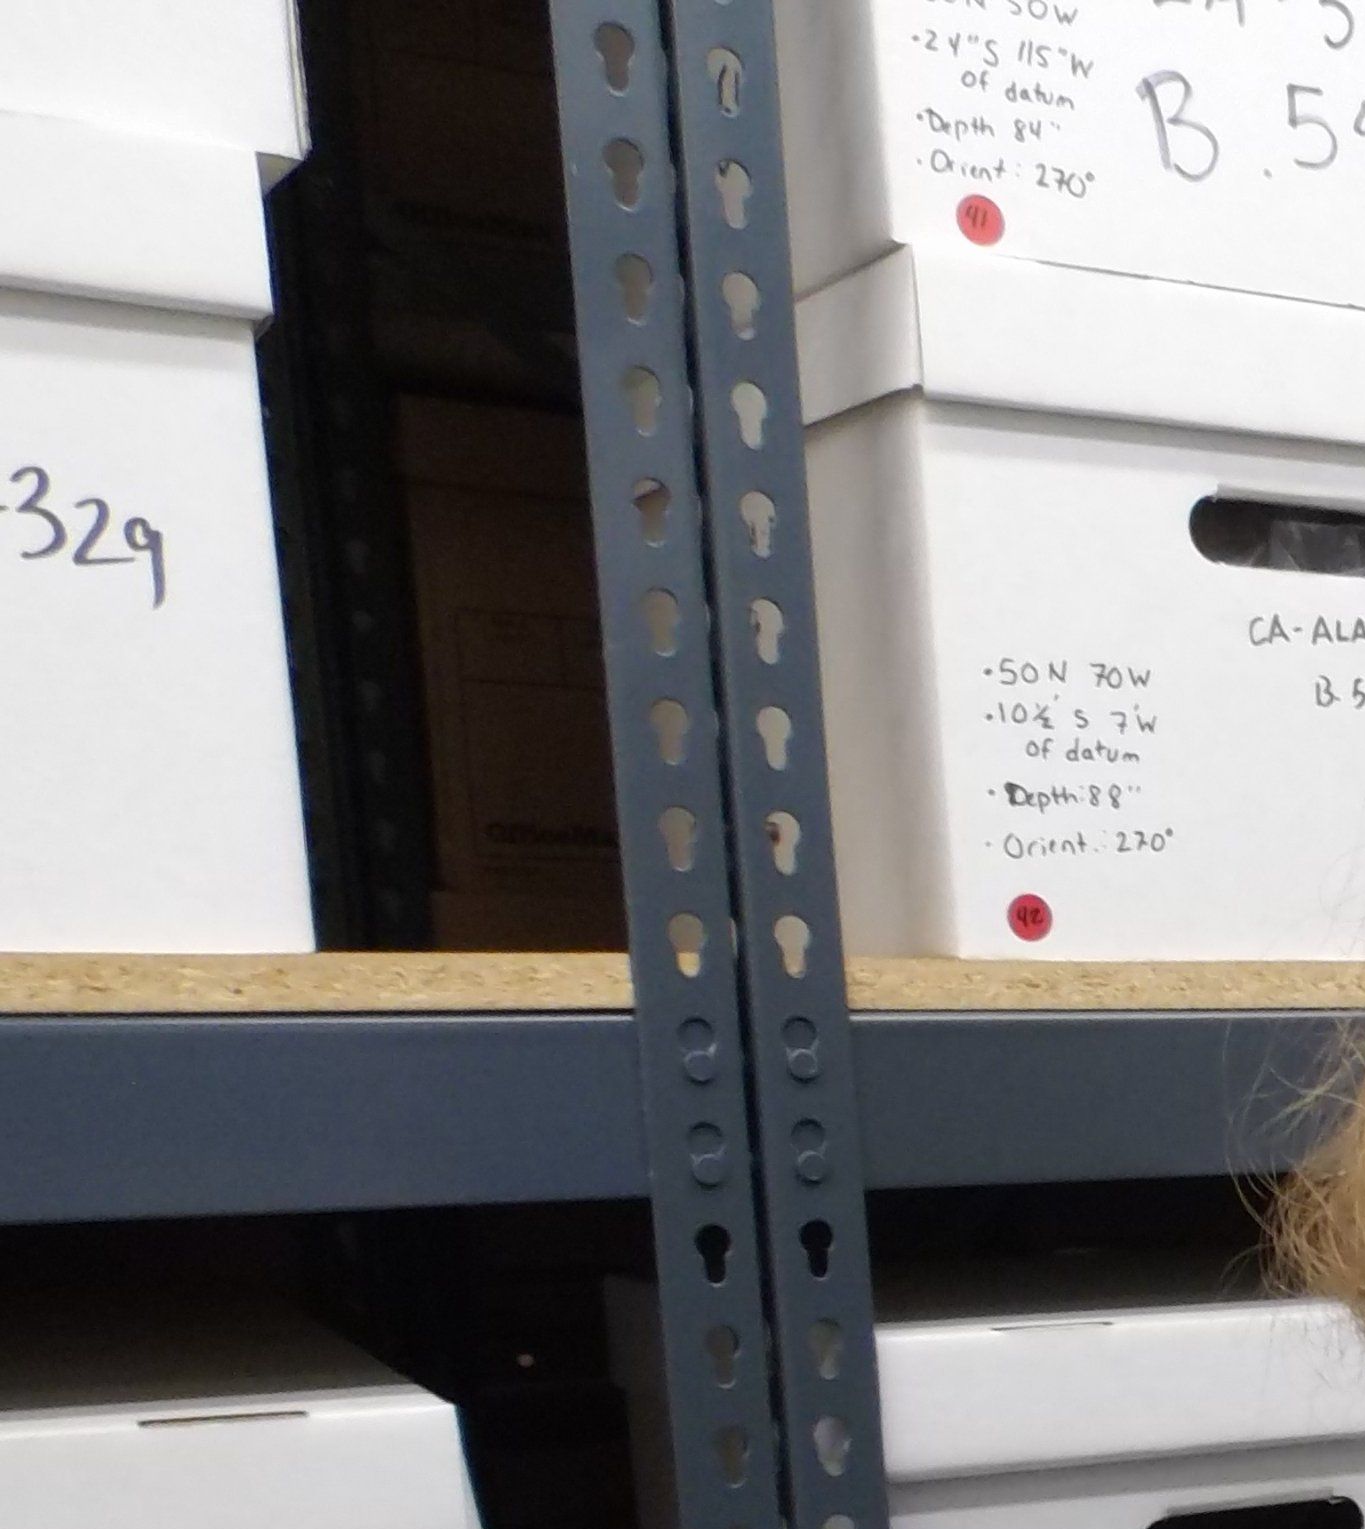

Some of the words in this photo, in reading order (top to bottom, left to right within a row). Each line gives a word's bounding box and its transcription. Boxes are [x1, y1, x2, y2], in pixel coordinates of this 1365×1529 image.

[961, 69, 989, 89] of
[1005, 77, 1075, 111] datum
[1025, 738, 1053, 760] of
[1066, 739, 1140, 763] datum
